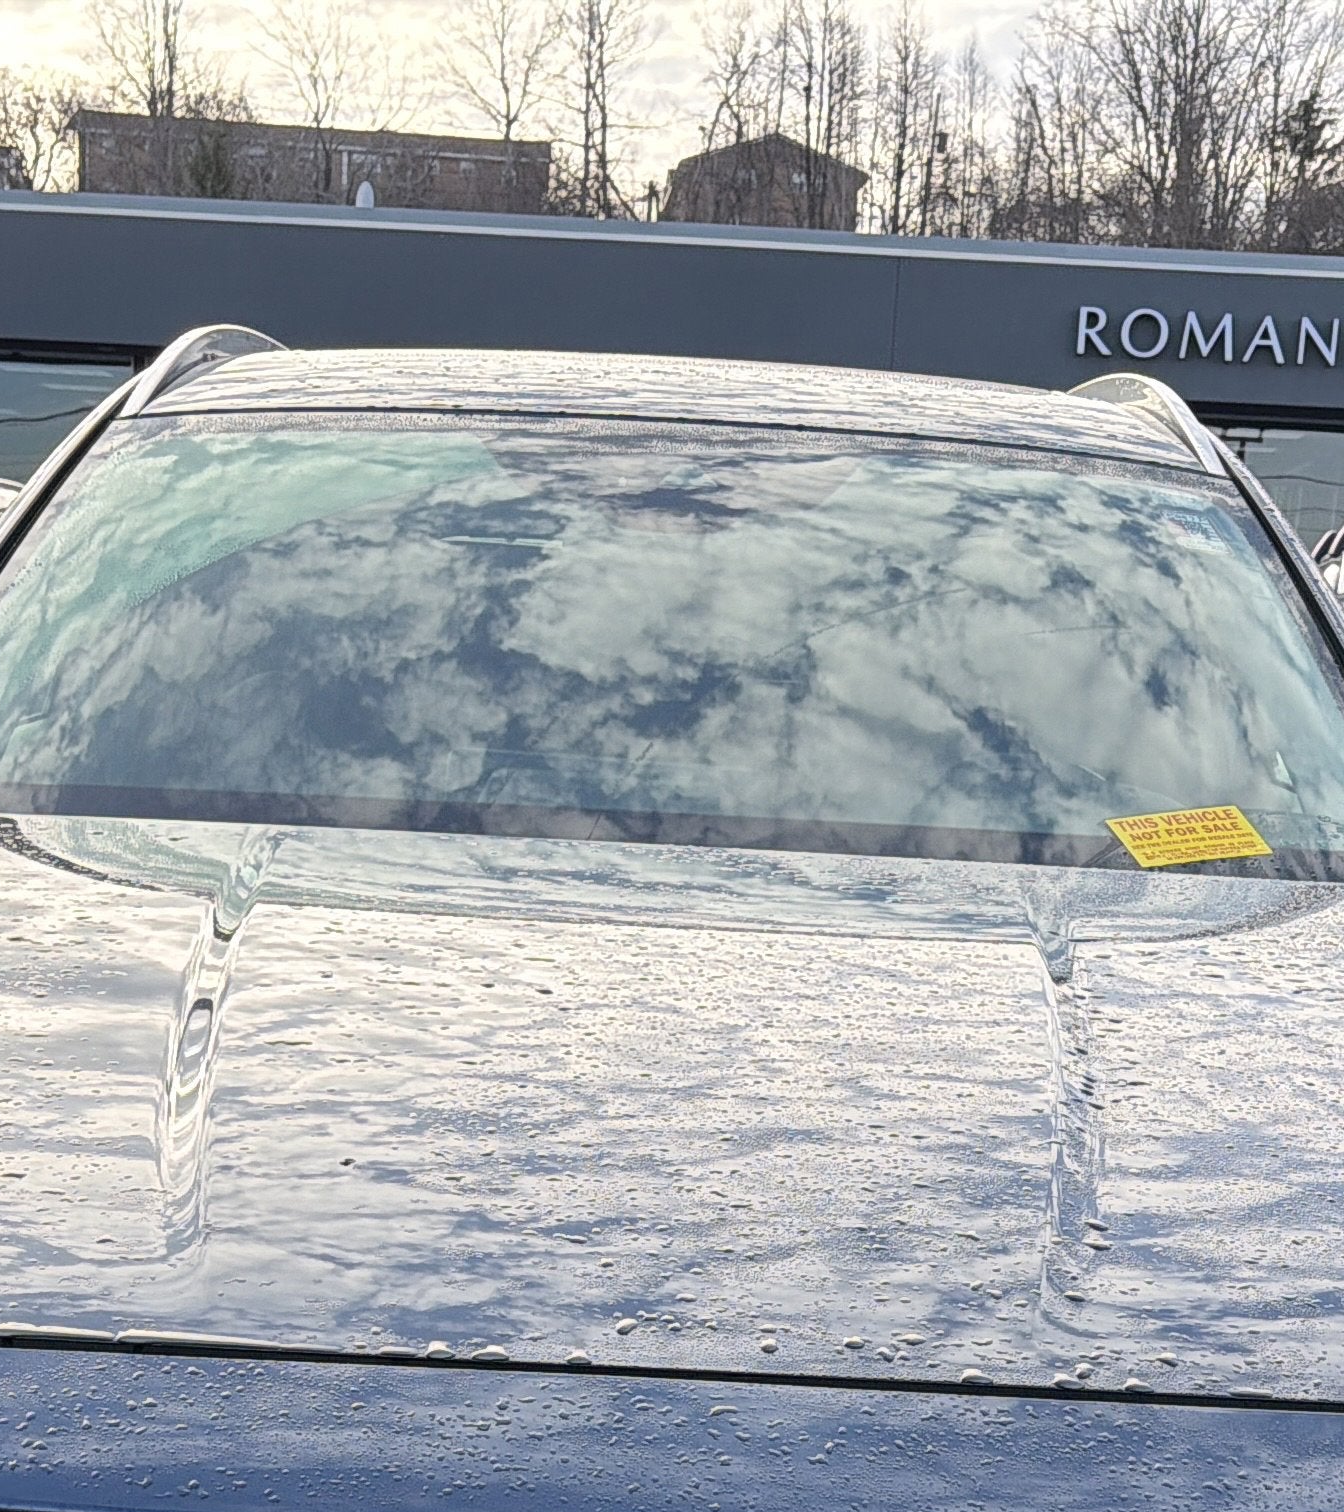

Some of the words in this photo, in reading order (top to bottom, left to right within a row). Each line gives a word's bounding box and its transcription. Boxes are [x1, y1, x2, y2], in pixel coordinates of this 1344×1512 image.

[1113, 817, 1159, 833] THIS
[1158, 808, 1239, 827] VEHICLE
[1128, 829, 1162, 842] NOT
[1164, 826, 1200, 838] FOR
[1201, 821, 1244, 834] SALE
